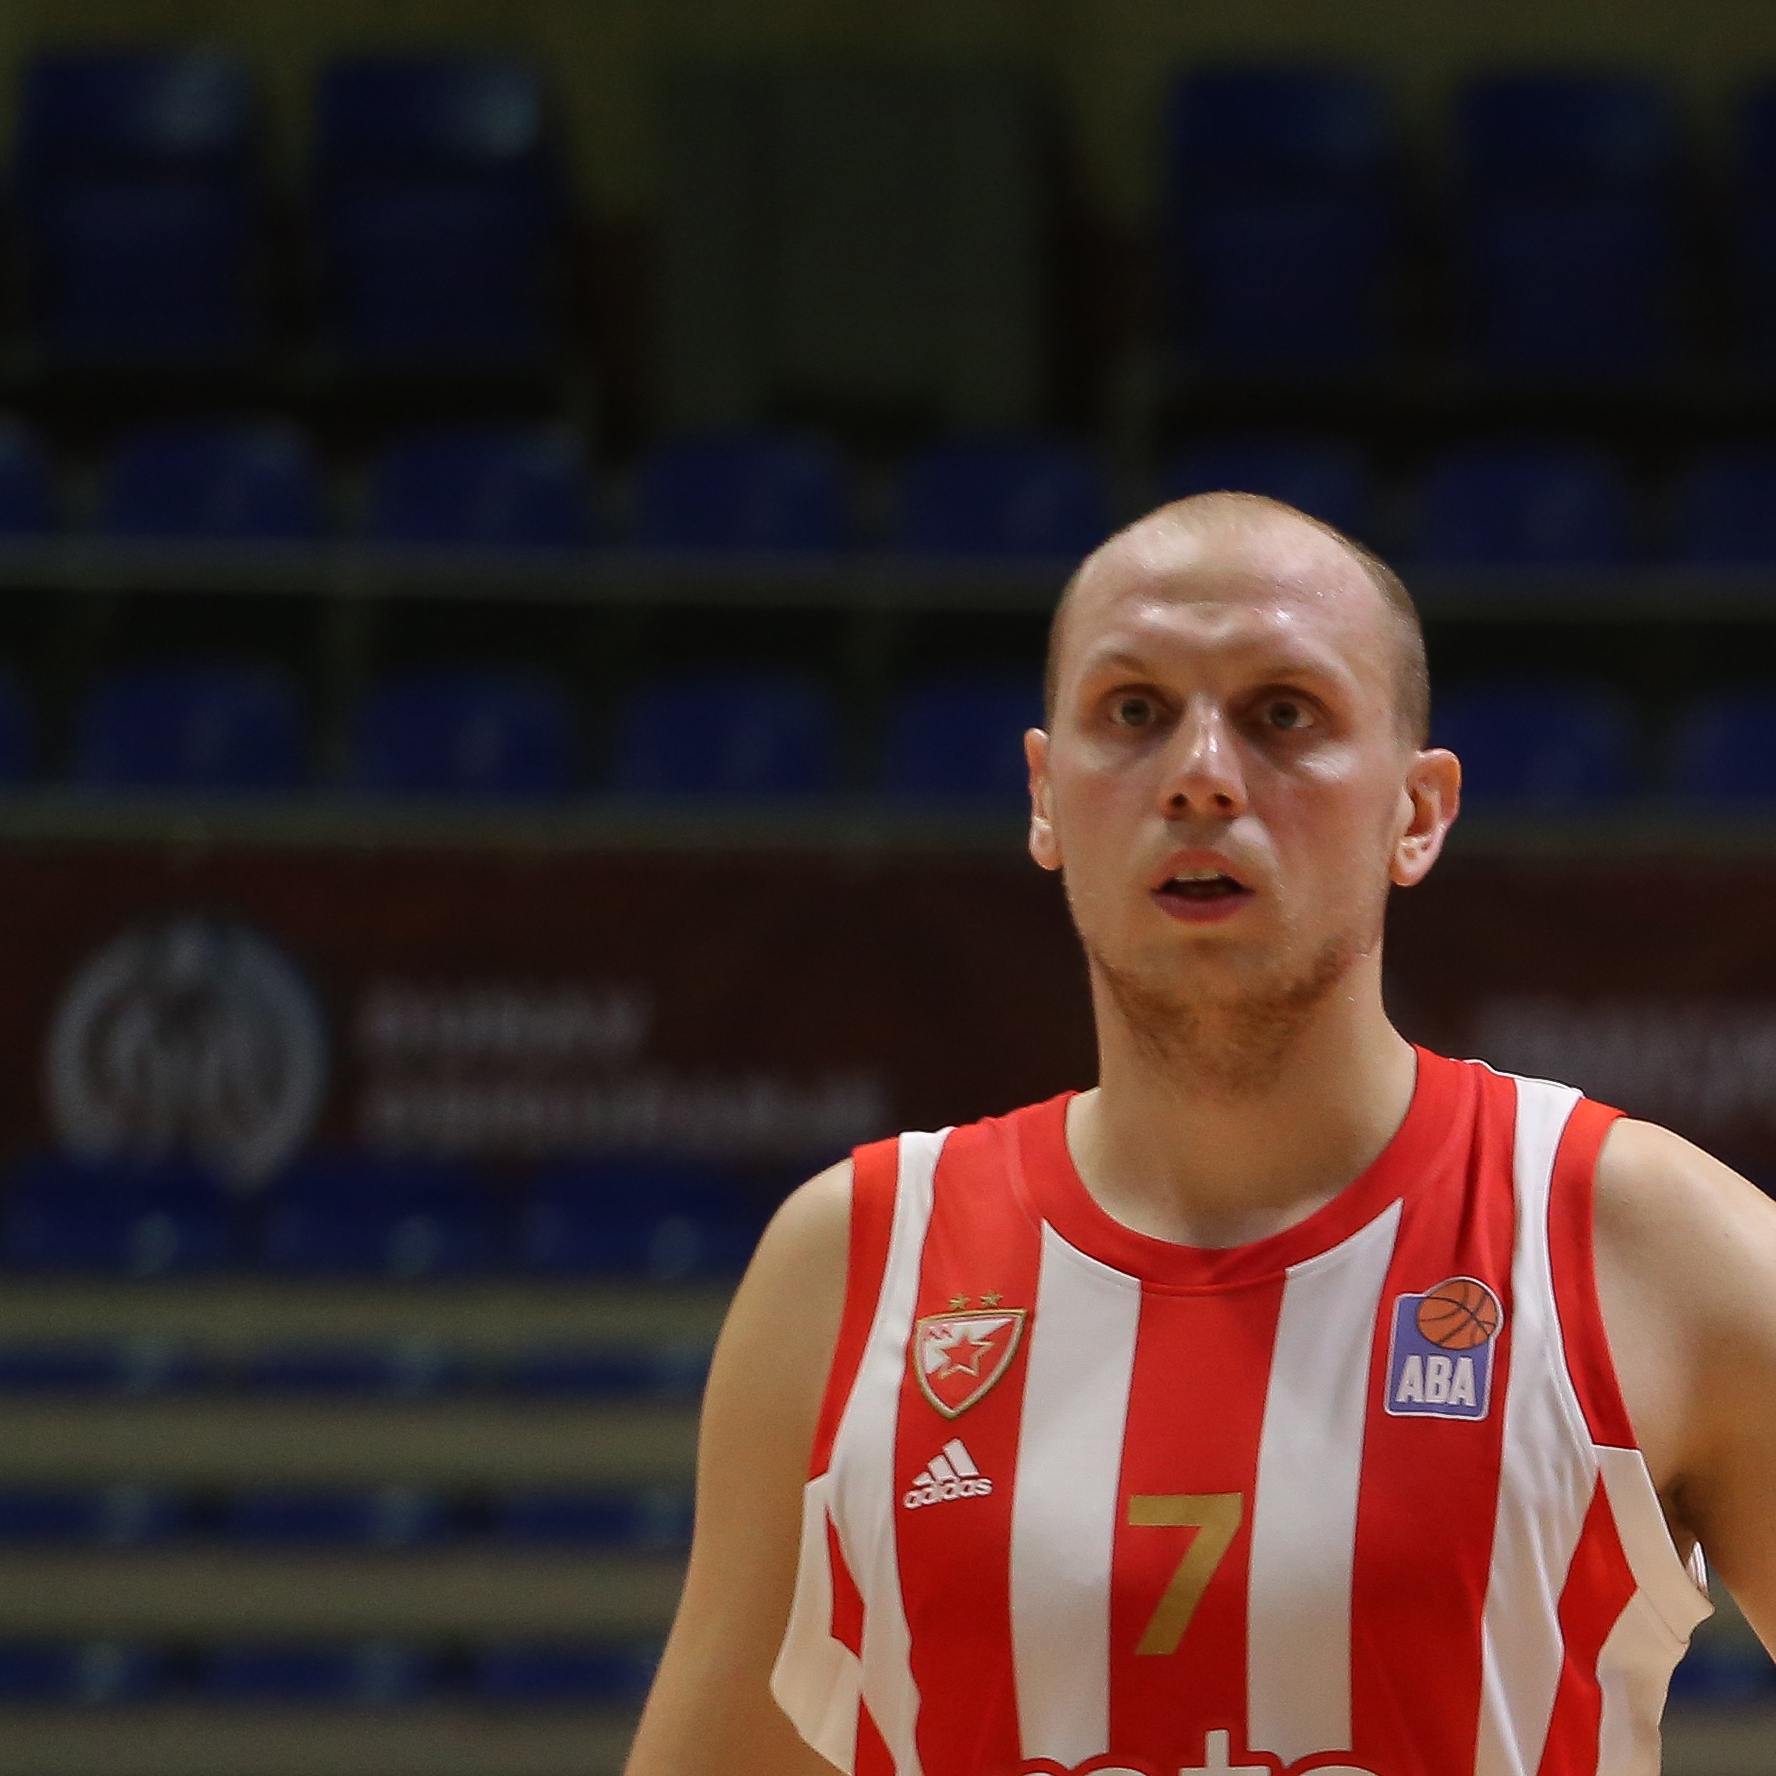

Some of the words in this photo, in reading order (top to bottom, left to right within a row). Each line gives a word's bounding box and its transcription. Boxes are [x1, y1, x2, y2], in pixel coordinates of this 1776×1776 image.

[1395, 1354, 1477, 1407] ABA
[903, 1478, 993, 1510] adidas
[1128, 1493, 1244, 1656] 7
